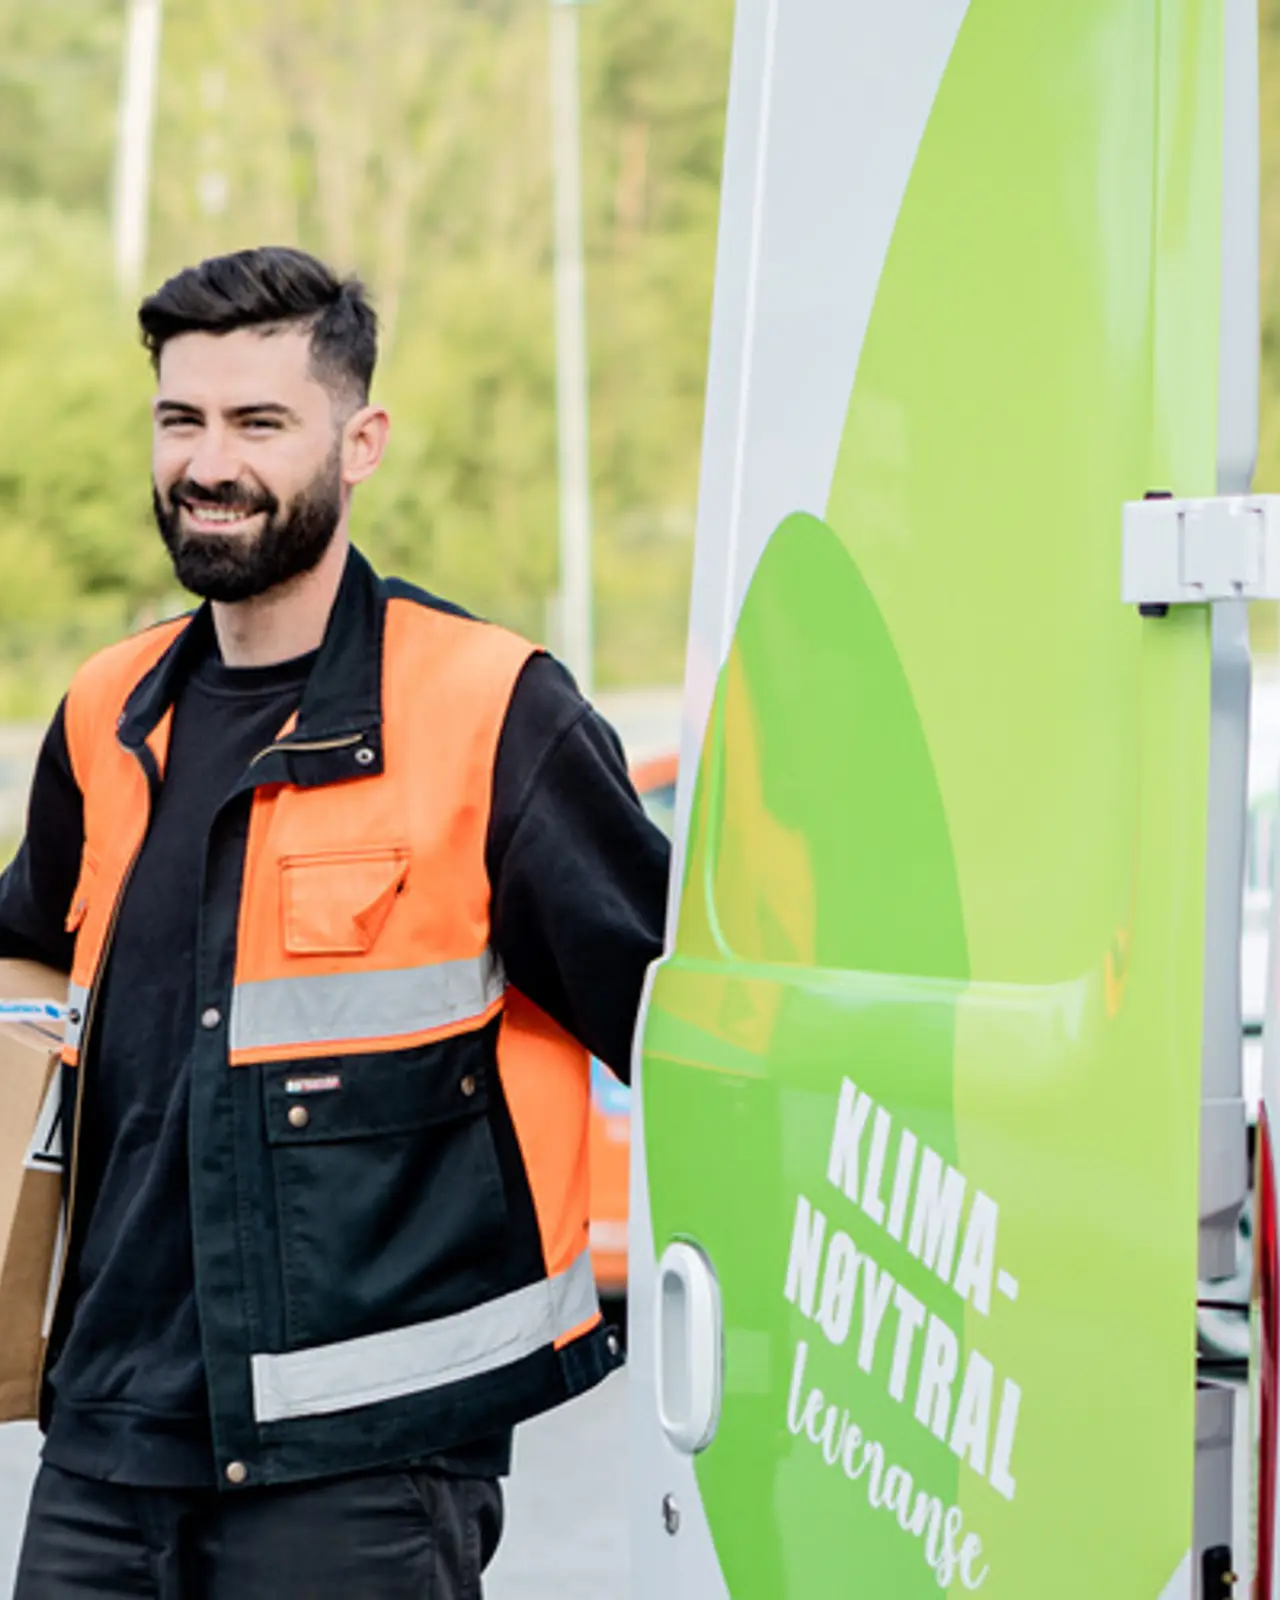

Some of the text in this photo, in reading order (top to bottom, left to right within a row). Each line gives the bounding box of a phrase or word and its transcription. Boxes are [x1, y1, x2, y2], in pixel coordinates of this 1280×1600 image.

[826, 1075, 1018, 1317] KLIMA-
[784, 1193, 1022, 1501] NØYTRAL
[787, 1340, 989, 1589] leveranse
